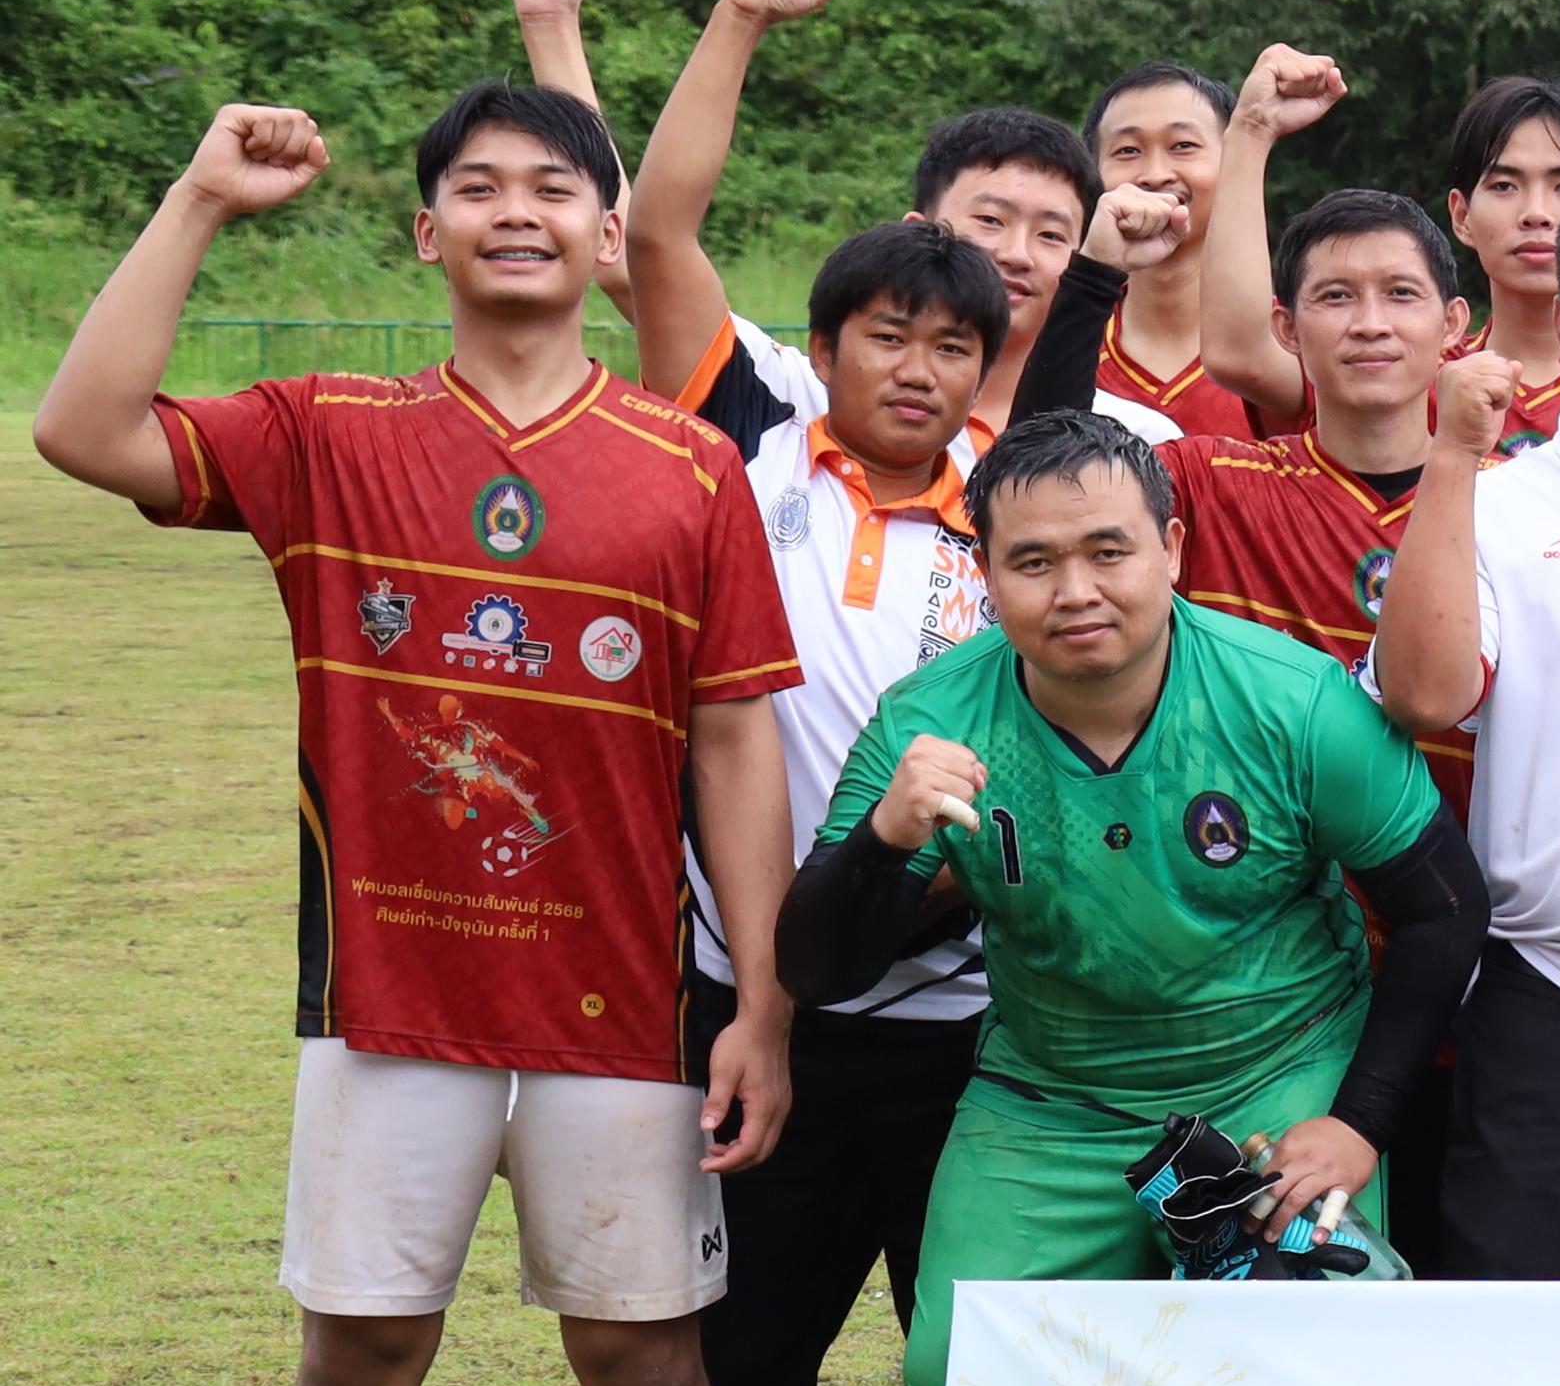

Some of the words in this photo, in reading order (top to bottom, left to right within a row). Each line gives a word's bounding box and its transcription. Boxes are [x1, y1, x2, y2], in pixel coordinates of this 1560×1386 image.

[619, 392, 724, 446] COMTMS
[990, 806, 1023, 886] 1
[352, 875, 539, 915] ฟุตบอลเชื่อมความสัมพันธ์
[543, 902, 584, 919] 2568
[498, 918, 538, 941] ครั้งที่
[543, 928, 550, 941] 1
[585, 1000, 600, 1010] XL
